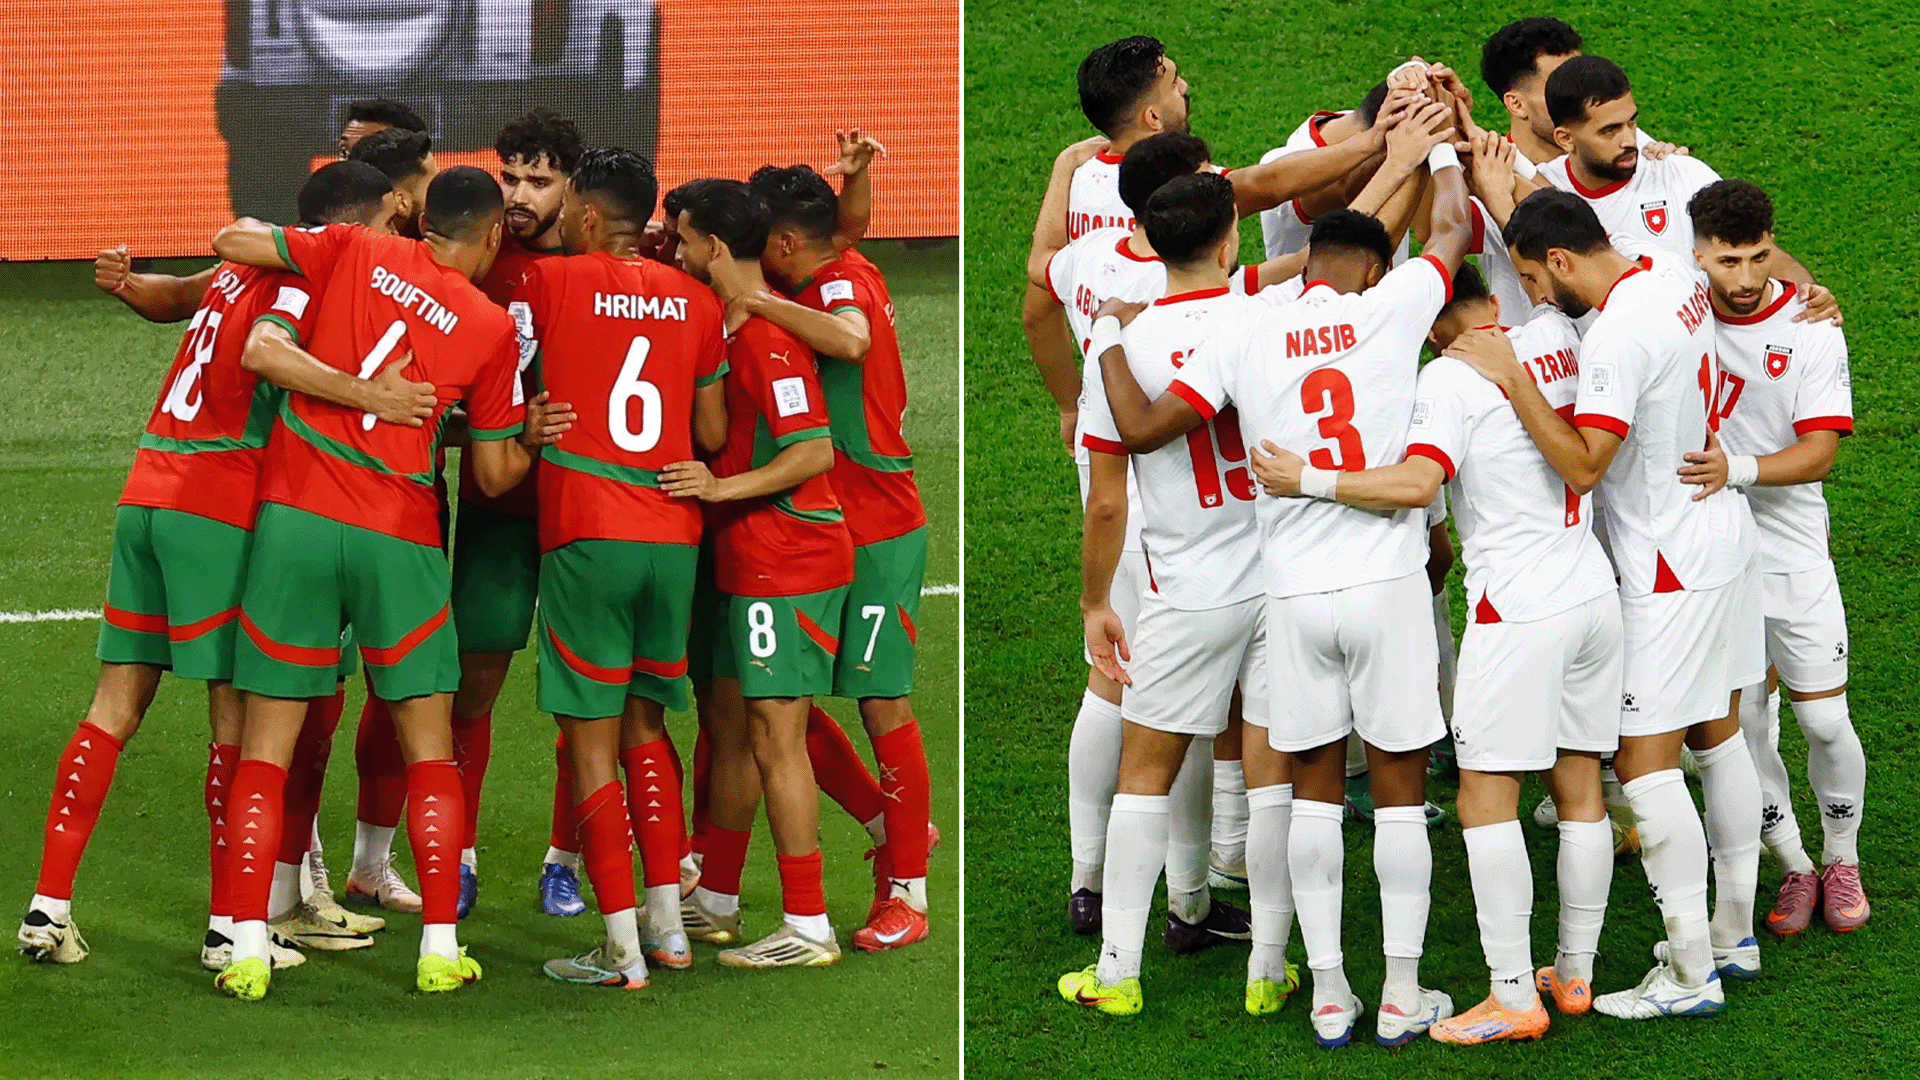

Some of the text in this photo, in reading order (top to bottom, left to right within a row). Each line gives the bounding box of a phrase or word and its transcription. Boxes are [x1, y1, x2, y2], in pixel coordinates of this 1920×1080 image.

[370, 265, 459, 335] BOUFTINI
[594, 292, 688, 321] HRIMAT
[161, 305, 223, 421] 18
[1286, 324, 1357, 358] NASIB
[608, 335, 662, 452] 6
[1300, 368, 1366, 472] 3
[748, 601, 777, 657] 8
[861, 605, 886, 662] 7
